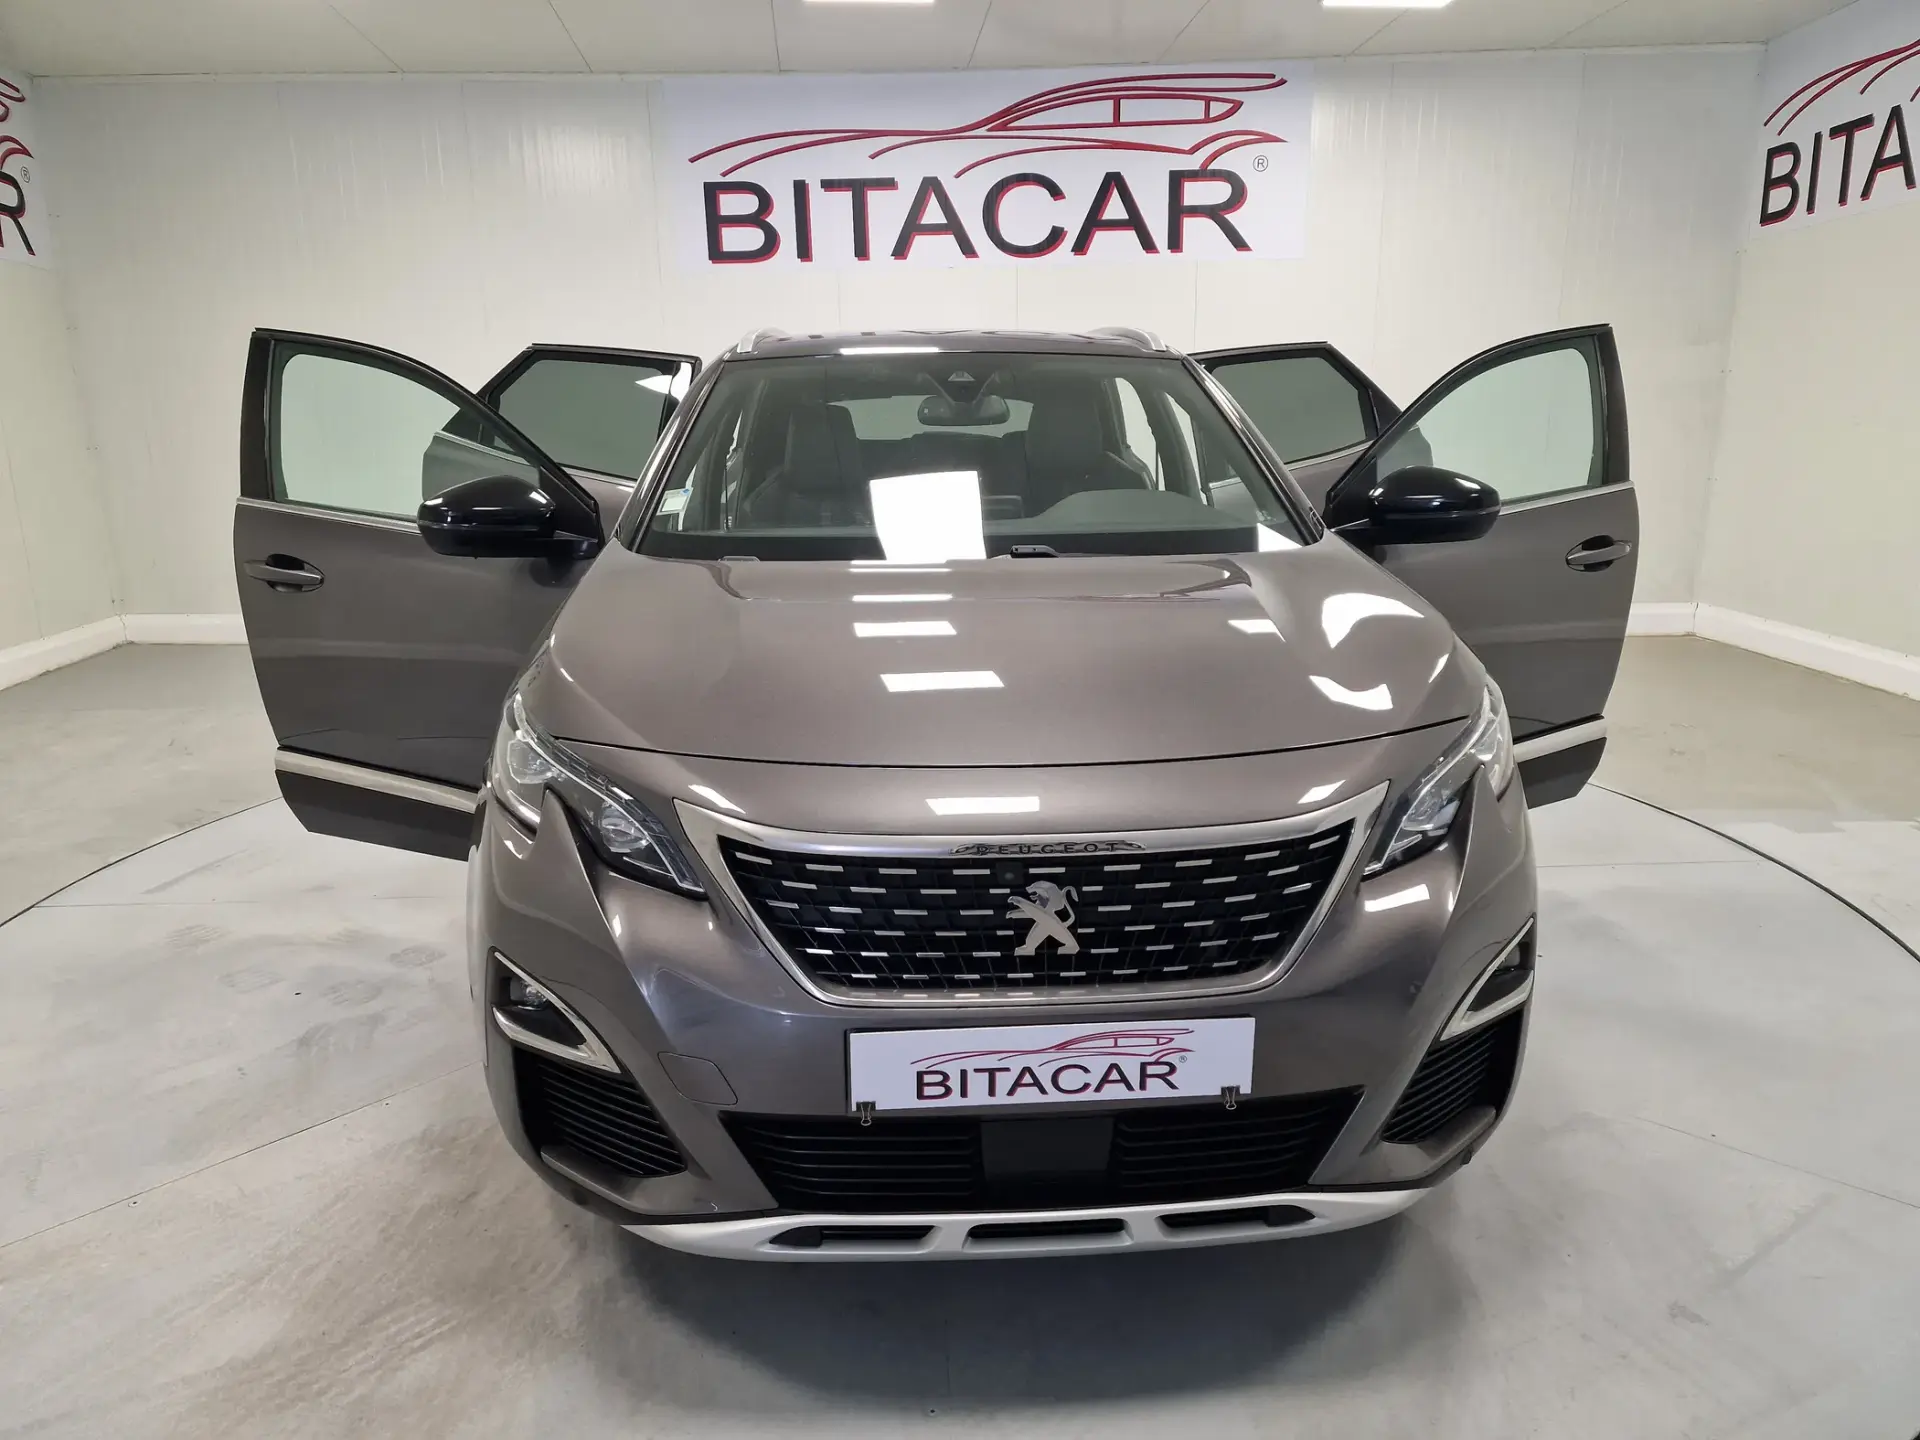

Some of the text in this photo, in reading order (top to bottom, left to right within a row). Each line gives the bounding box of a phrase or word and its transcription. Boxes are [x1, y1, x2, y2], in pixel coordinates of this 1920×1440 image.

[703, 169, 1252, 263] BITACAR
[976, 842, 1120, 855] PEUGEOT
[916, 1061, 1180, 1100] BITACAR
